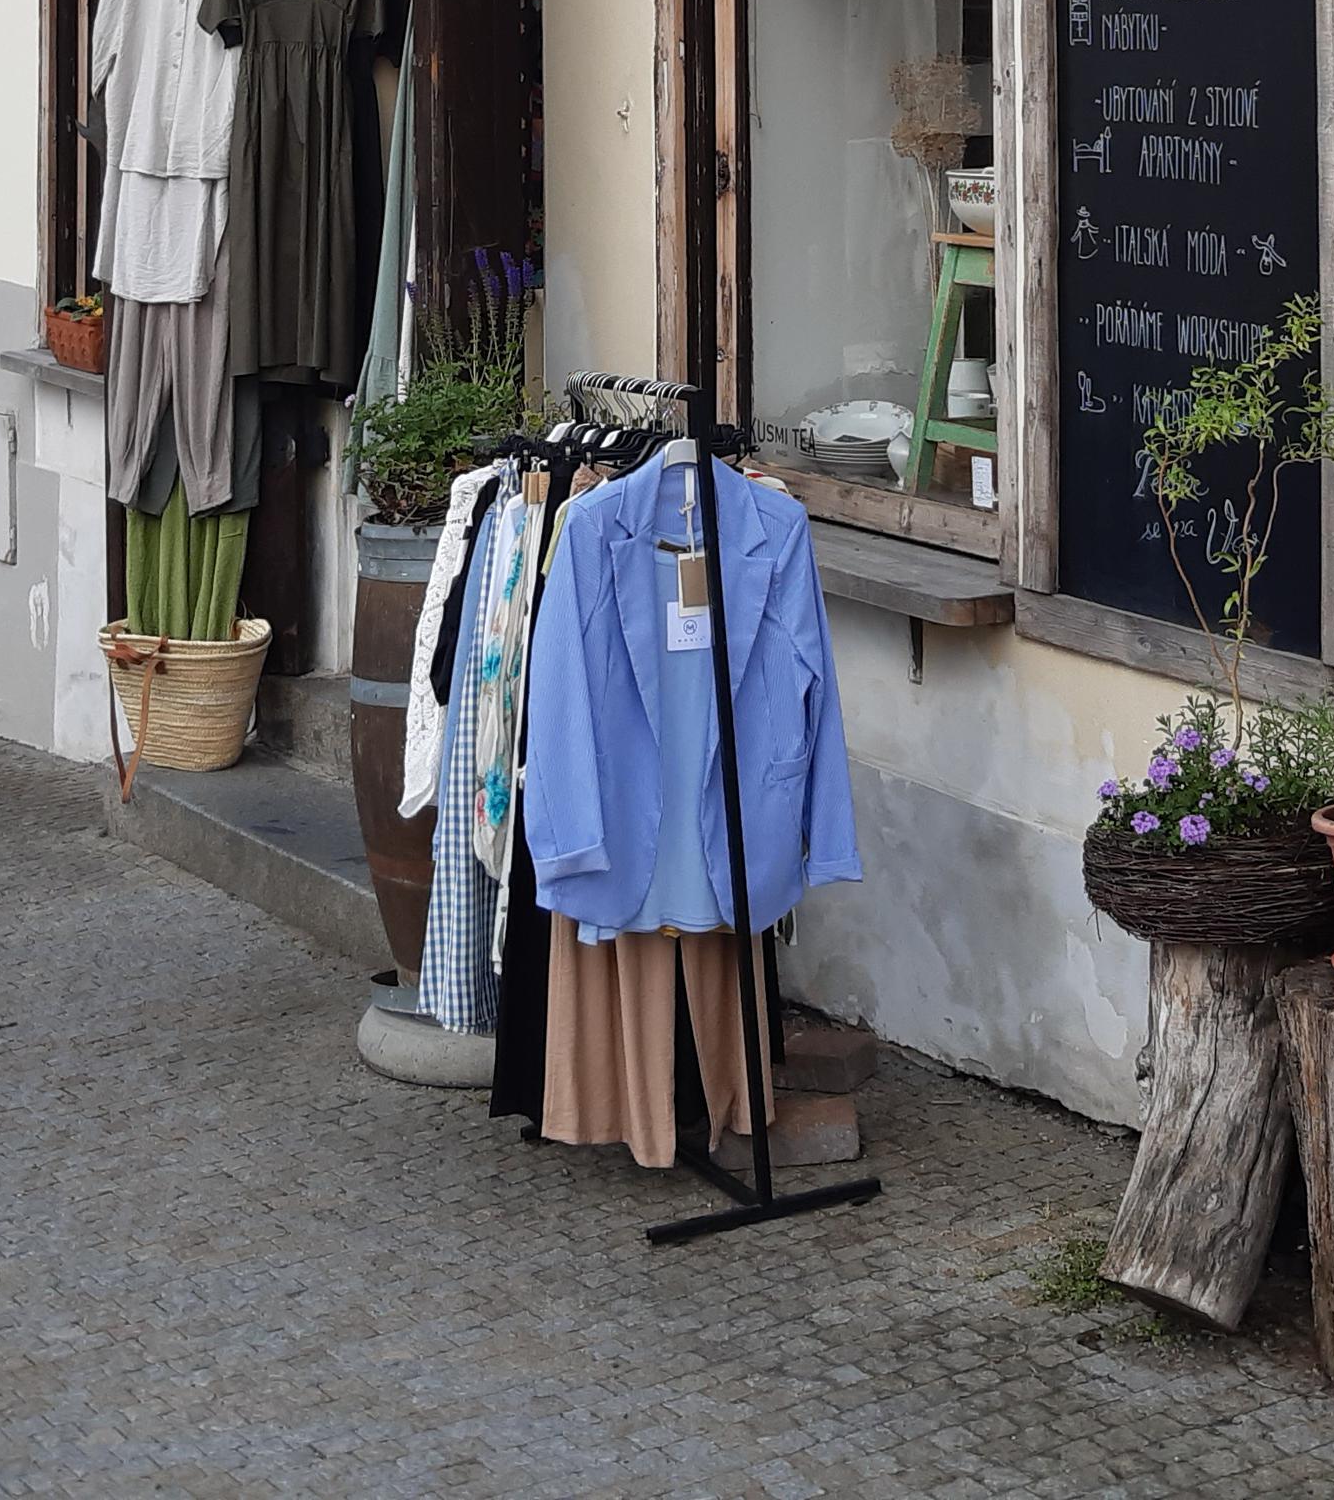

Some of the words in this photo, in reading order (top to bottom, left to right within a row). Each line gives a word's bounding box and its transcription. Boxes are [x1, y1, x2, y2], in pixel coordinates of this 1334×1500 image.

[1101, 7, 1159, 51] NÁBYTKU
[1102, 78, 1176, 124] UBYTOVÁNÍ
[1205, 80, 1261, 128] STYLOVÉ
[1138, 135, 1223, 185] APARTMÁNY
[1115, 224, 1171, 267] ITALSKÁ
[1187, 225, 1227, 276] MÓDA
[1096, 300, 1163, 351] POŘÁDÁME
[792, 427, 816, 457] TEA
